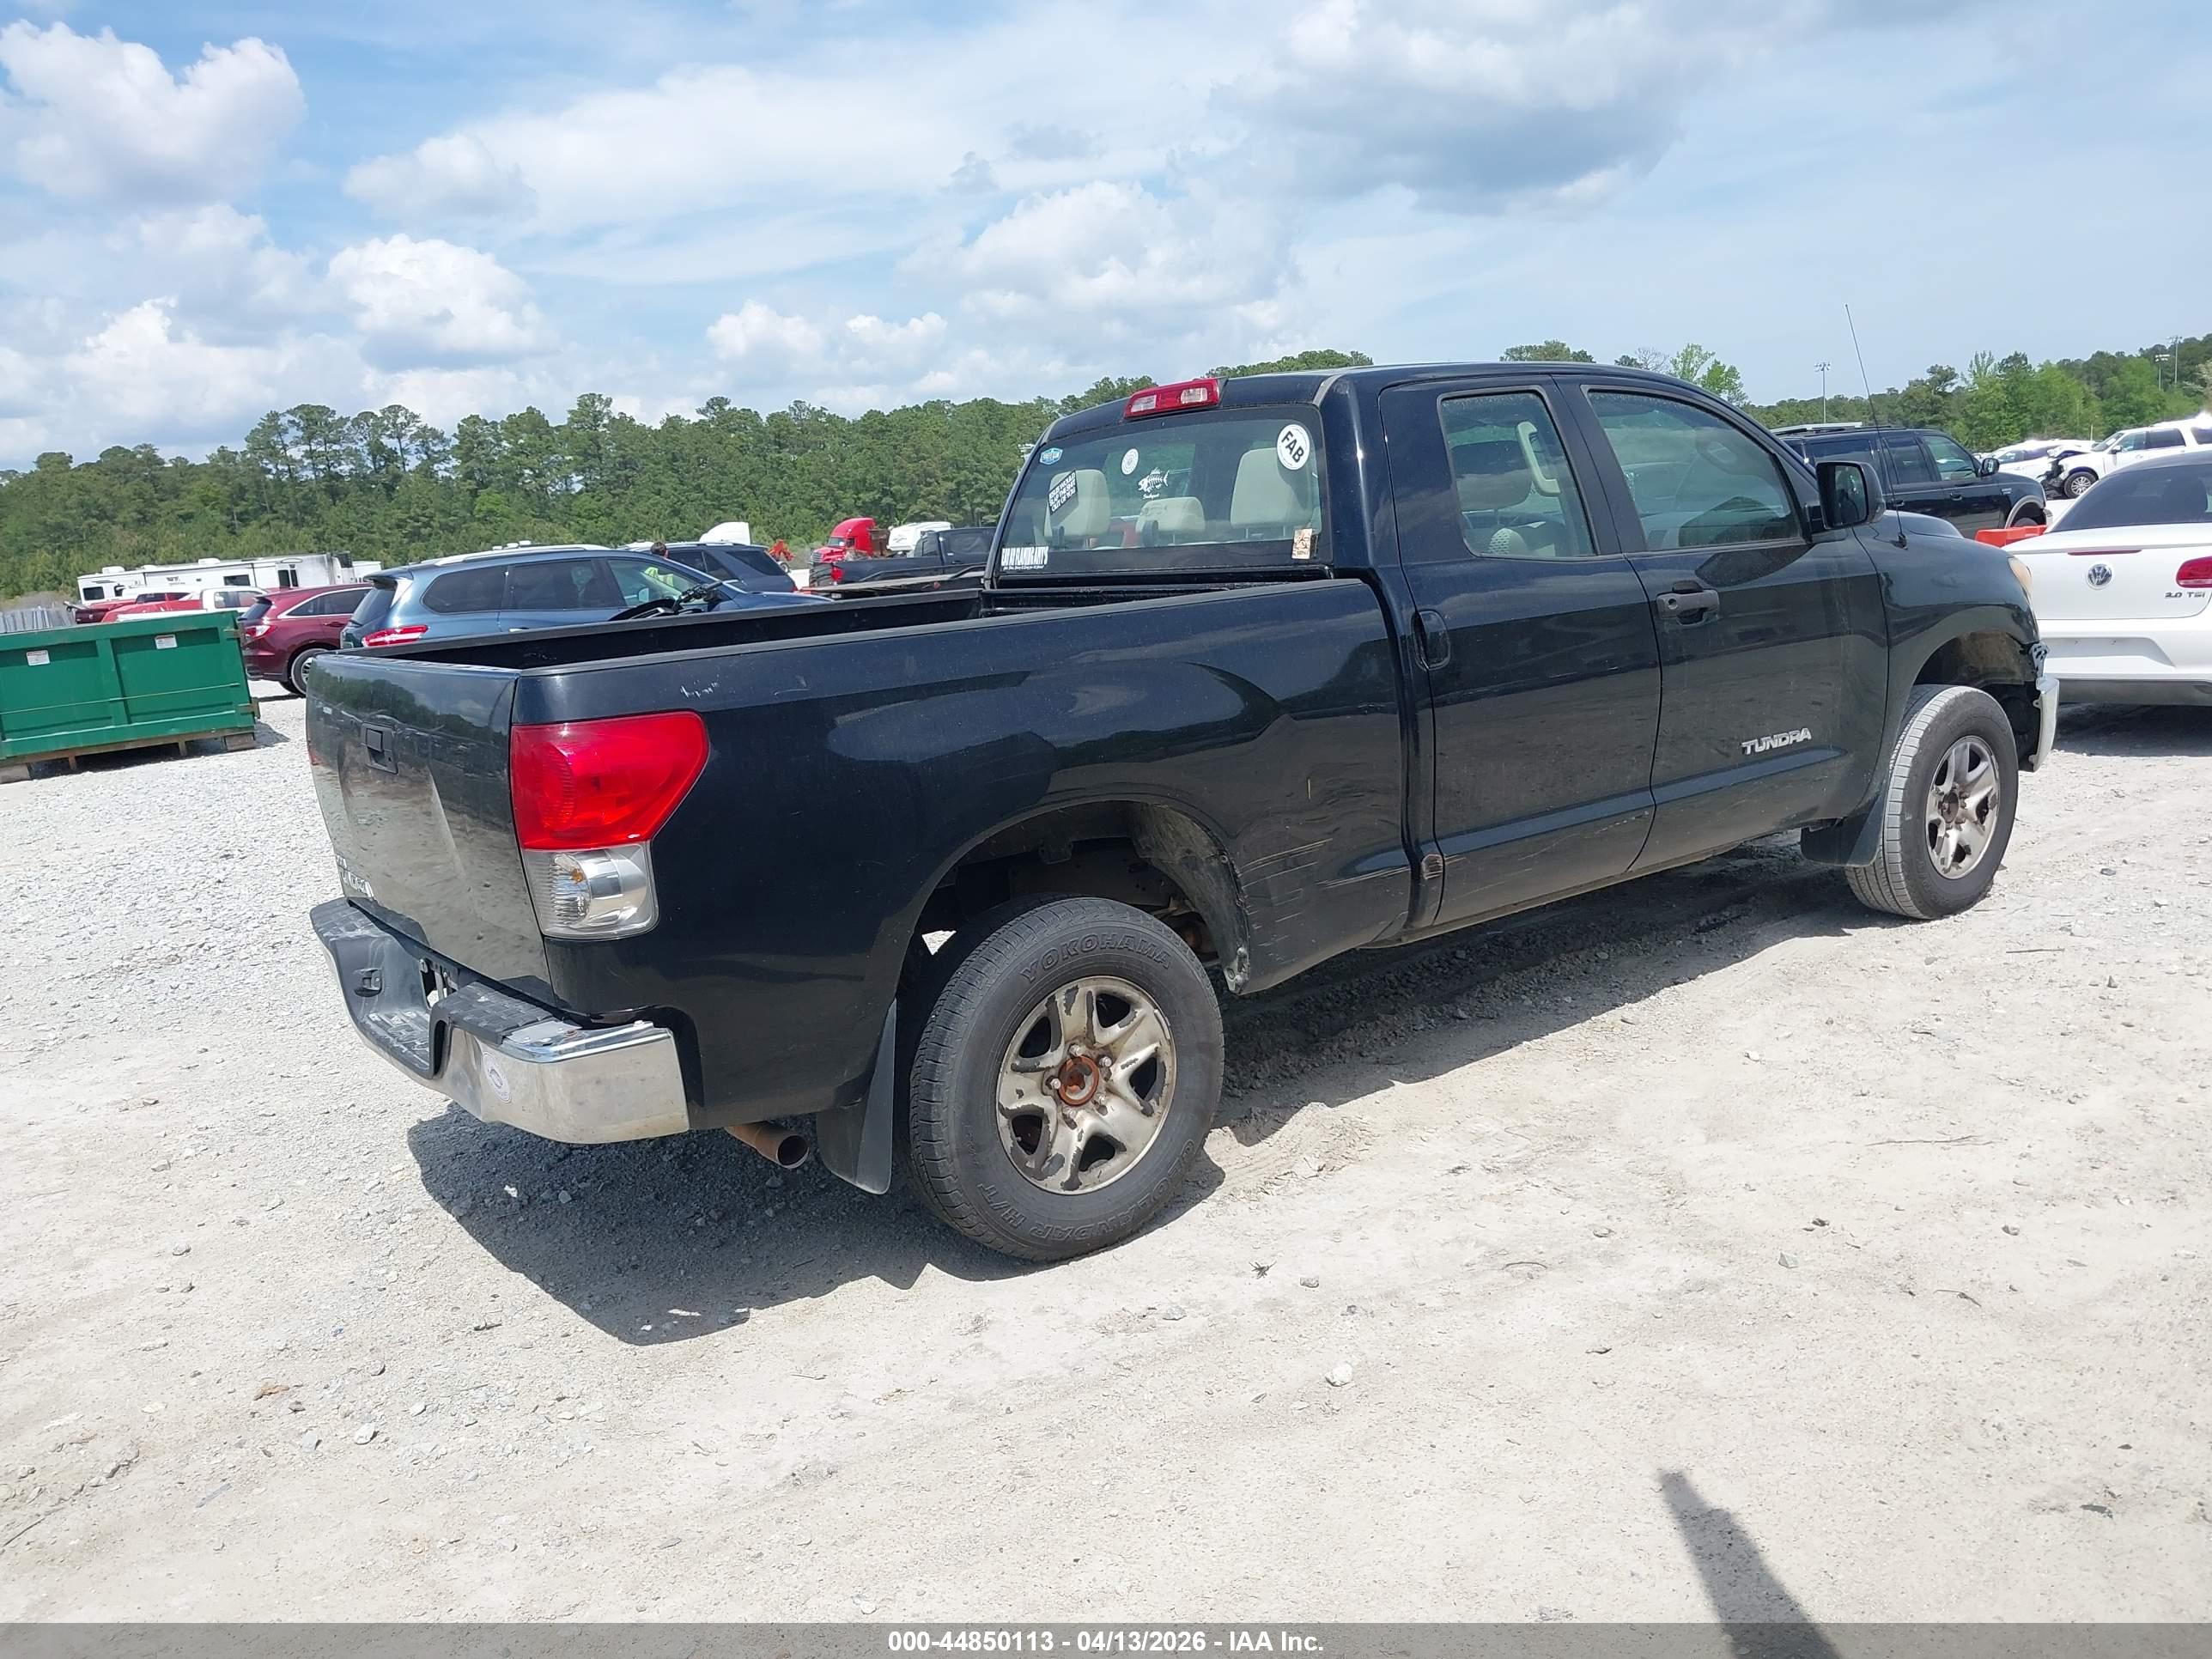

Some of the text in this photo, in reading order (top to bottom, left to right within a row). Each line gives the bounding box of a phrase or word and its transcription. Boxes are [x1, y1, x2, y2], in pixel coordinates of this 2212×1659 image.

[1281, 430, 1304, 463] FAB
[1059, 472, 1075, 490] WOULD
[1052, 500, 1061, 512] OUT
[1066, 487, 1076, 498] YOU
[1741, 727, 1812, 756] TUNDRA
[1020, 932, 1171, 983] YOKOHAMA
[977, 1182, 1028, 1229] H/T
[1030, 1139, 1196, 1242] GEOLANDAR
